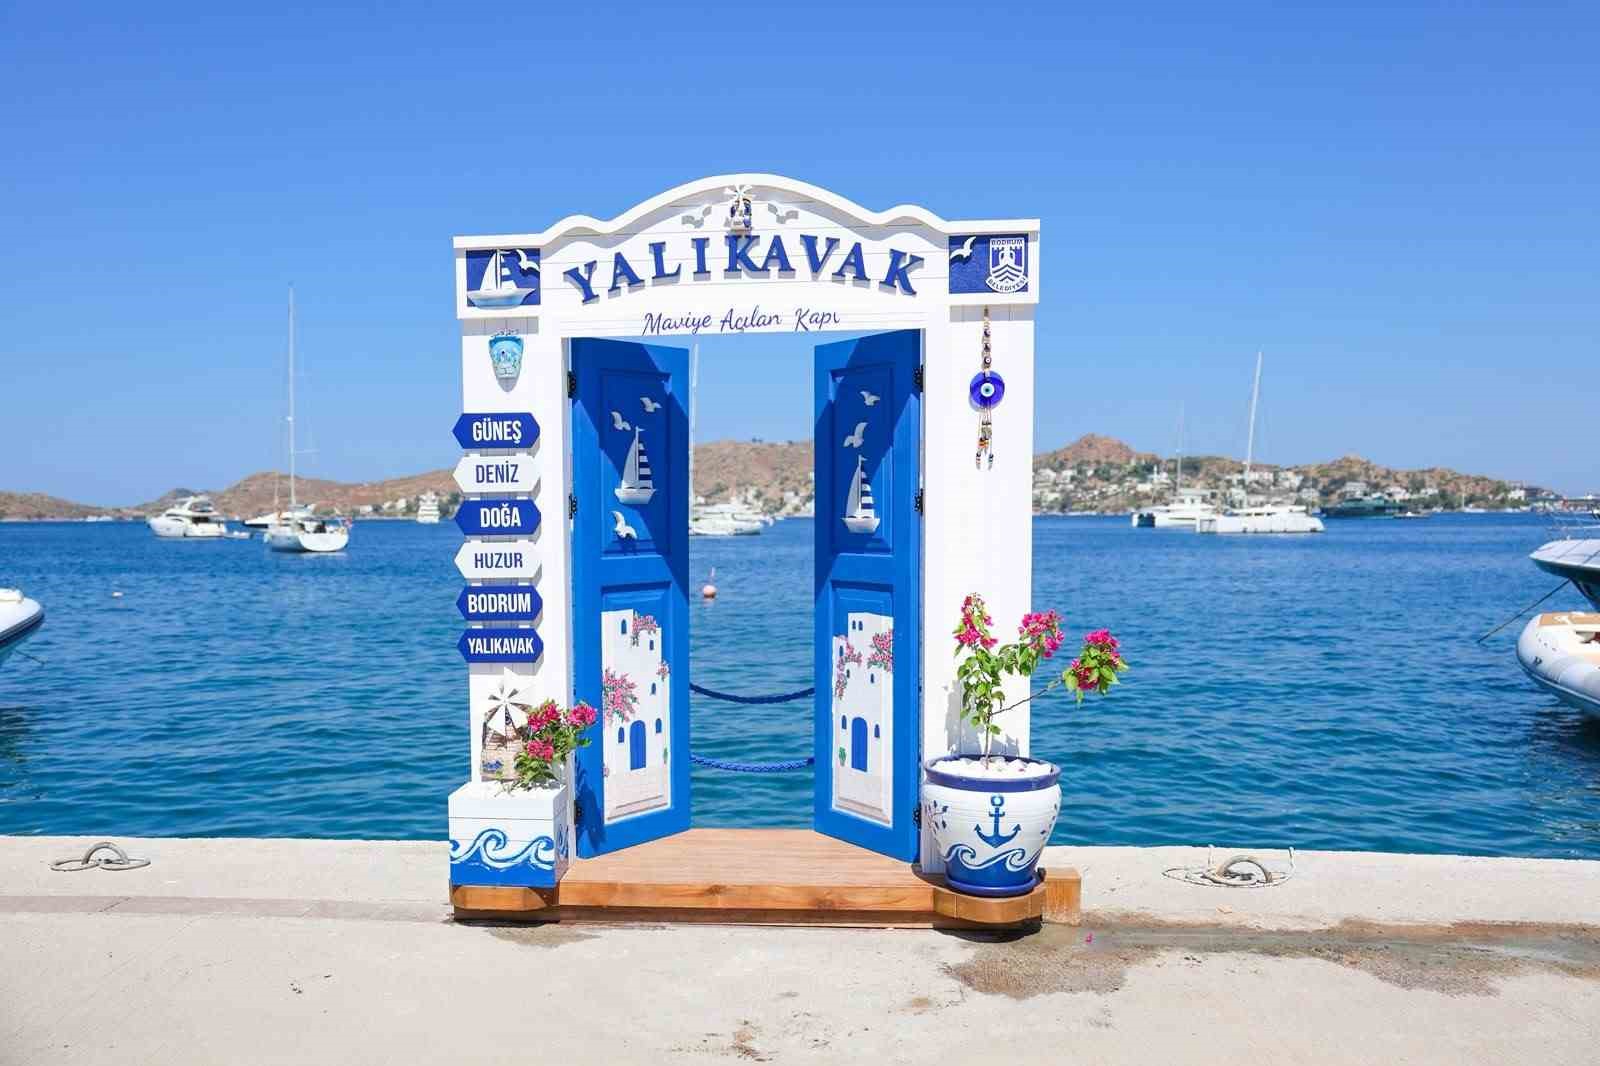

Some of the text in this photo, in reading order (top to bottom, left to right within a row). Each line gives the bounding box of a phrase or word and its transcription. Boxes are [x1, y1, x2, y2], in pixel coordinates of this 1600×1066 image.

[564, 234, 925, 305] YALIKAVAK
[642, 312, 713, 336] Maviye
[794, 308, 840, 332] Kapı
[472, 418, 522, 444] GÜNEŞ
[475, 460, 520, 484] DENİZ
[480, 503, 522, 528] DOĞA
[474, 552, 523, 569] HUZUR
[467, 593, 532, 613] BODRUM
[467, 637, 535, 655] YALIKAVAK
